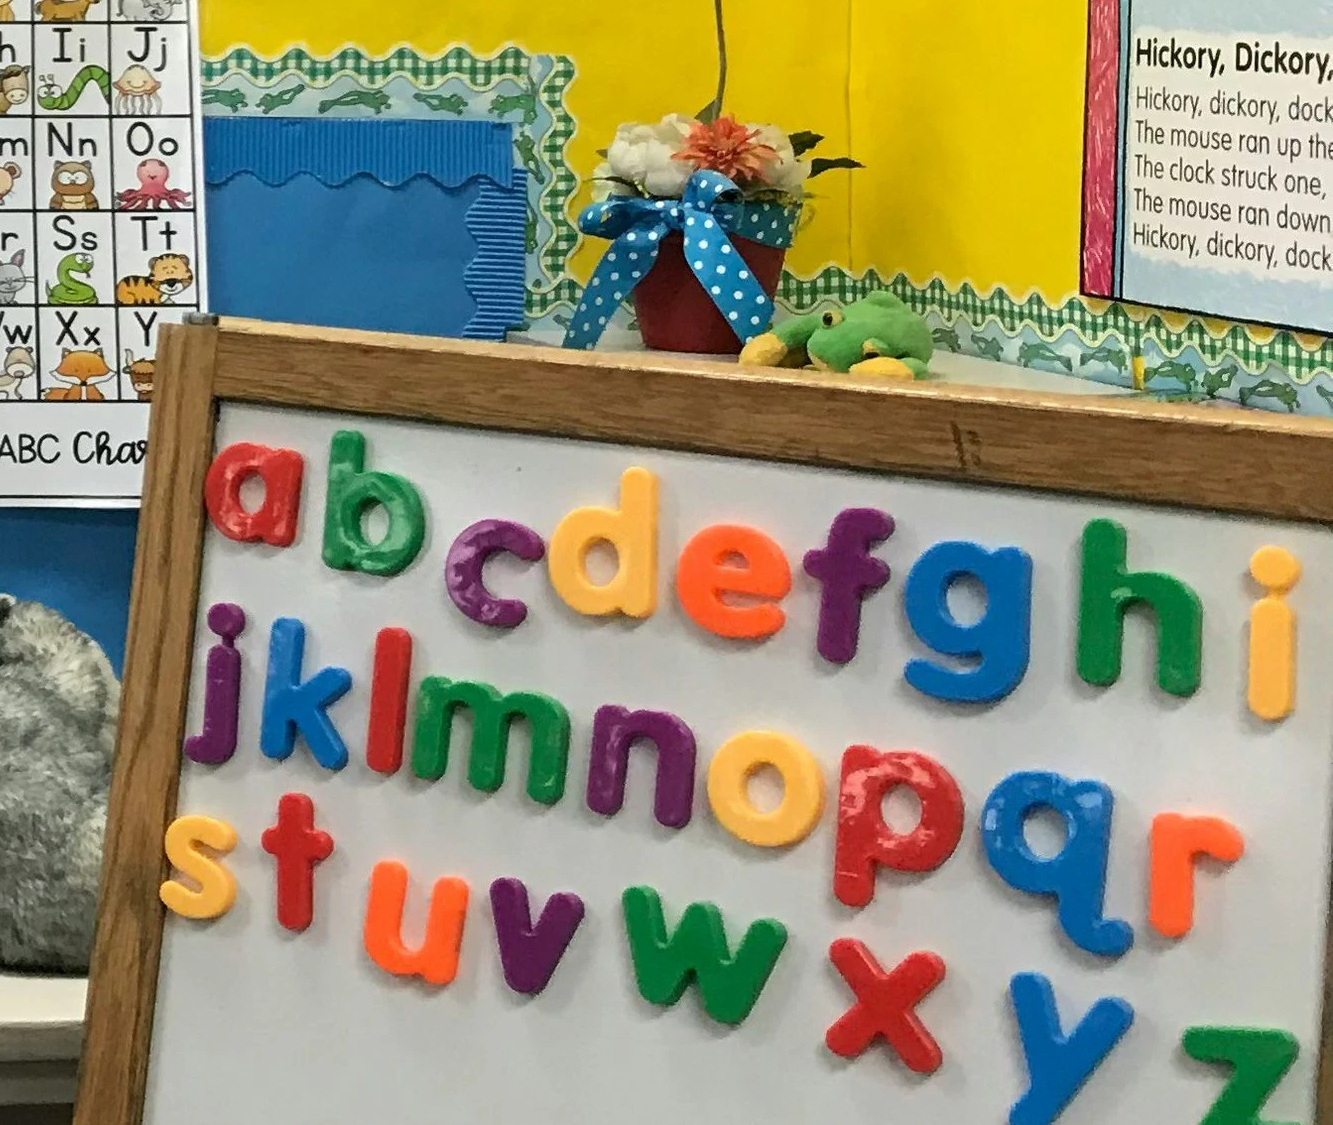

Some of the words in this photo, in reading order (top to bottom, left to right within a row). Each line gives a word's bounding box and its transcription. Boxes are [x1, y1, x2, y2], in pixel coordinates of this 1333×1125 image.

[52, 27, 85, 62] Ii
[127, 26, 167, 71] Jj
[1136, 37, 1225, 75] Hickory,
[1236, 41, 1333, 83] Dickory,
[1136, 87, 1202, 119] Hickory,
[1210, 89, 1280, 122] dickory,
[1289, 95, 1333, 121] dock
[48, 121, 96, 157] Nn
[1136, 120, 1164, 144] The
[1170, 129, 1232, 150] mouse
[1239, 133, 1270, 154] ran
[1278, 138, 1301, 162] up
[1135, 154, 1164, 178] The
[1169, 158, 1214, 185] clock
[1221, 165, 1277, 191] struck
[1285, 174, 1326, 200] one,
[1134, 188, 1163, 212] The
[1169, 197, 1231, 221] mouse
[1238, 203, 1269, 226] ran
[1277, 205, 1330, 233] down
[52, 215, 97, 251] Ss
[131, 216, 177, 251] Tt
[1134, 222, 1198, 258] Hickory,
[1207, 231, 1277, 269] dickory,
[1286, 241, 1332, 270] dock
[56, 311, 100, 346] Xx
[134, 312, 157, 347] Y
[73, 431, 148, 464] Cha
